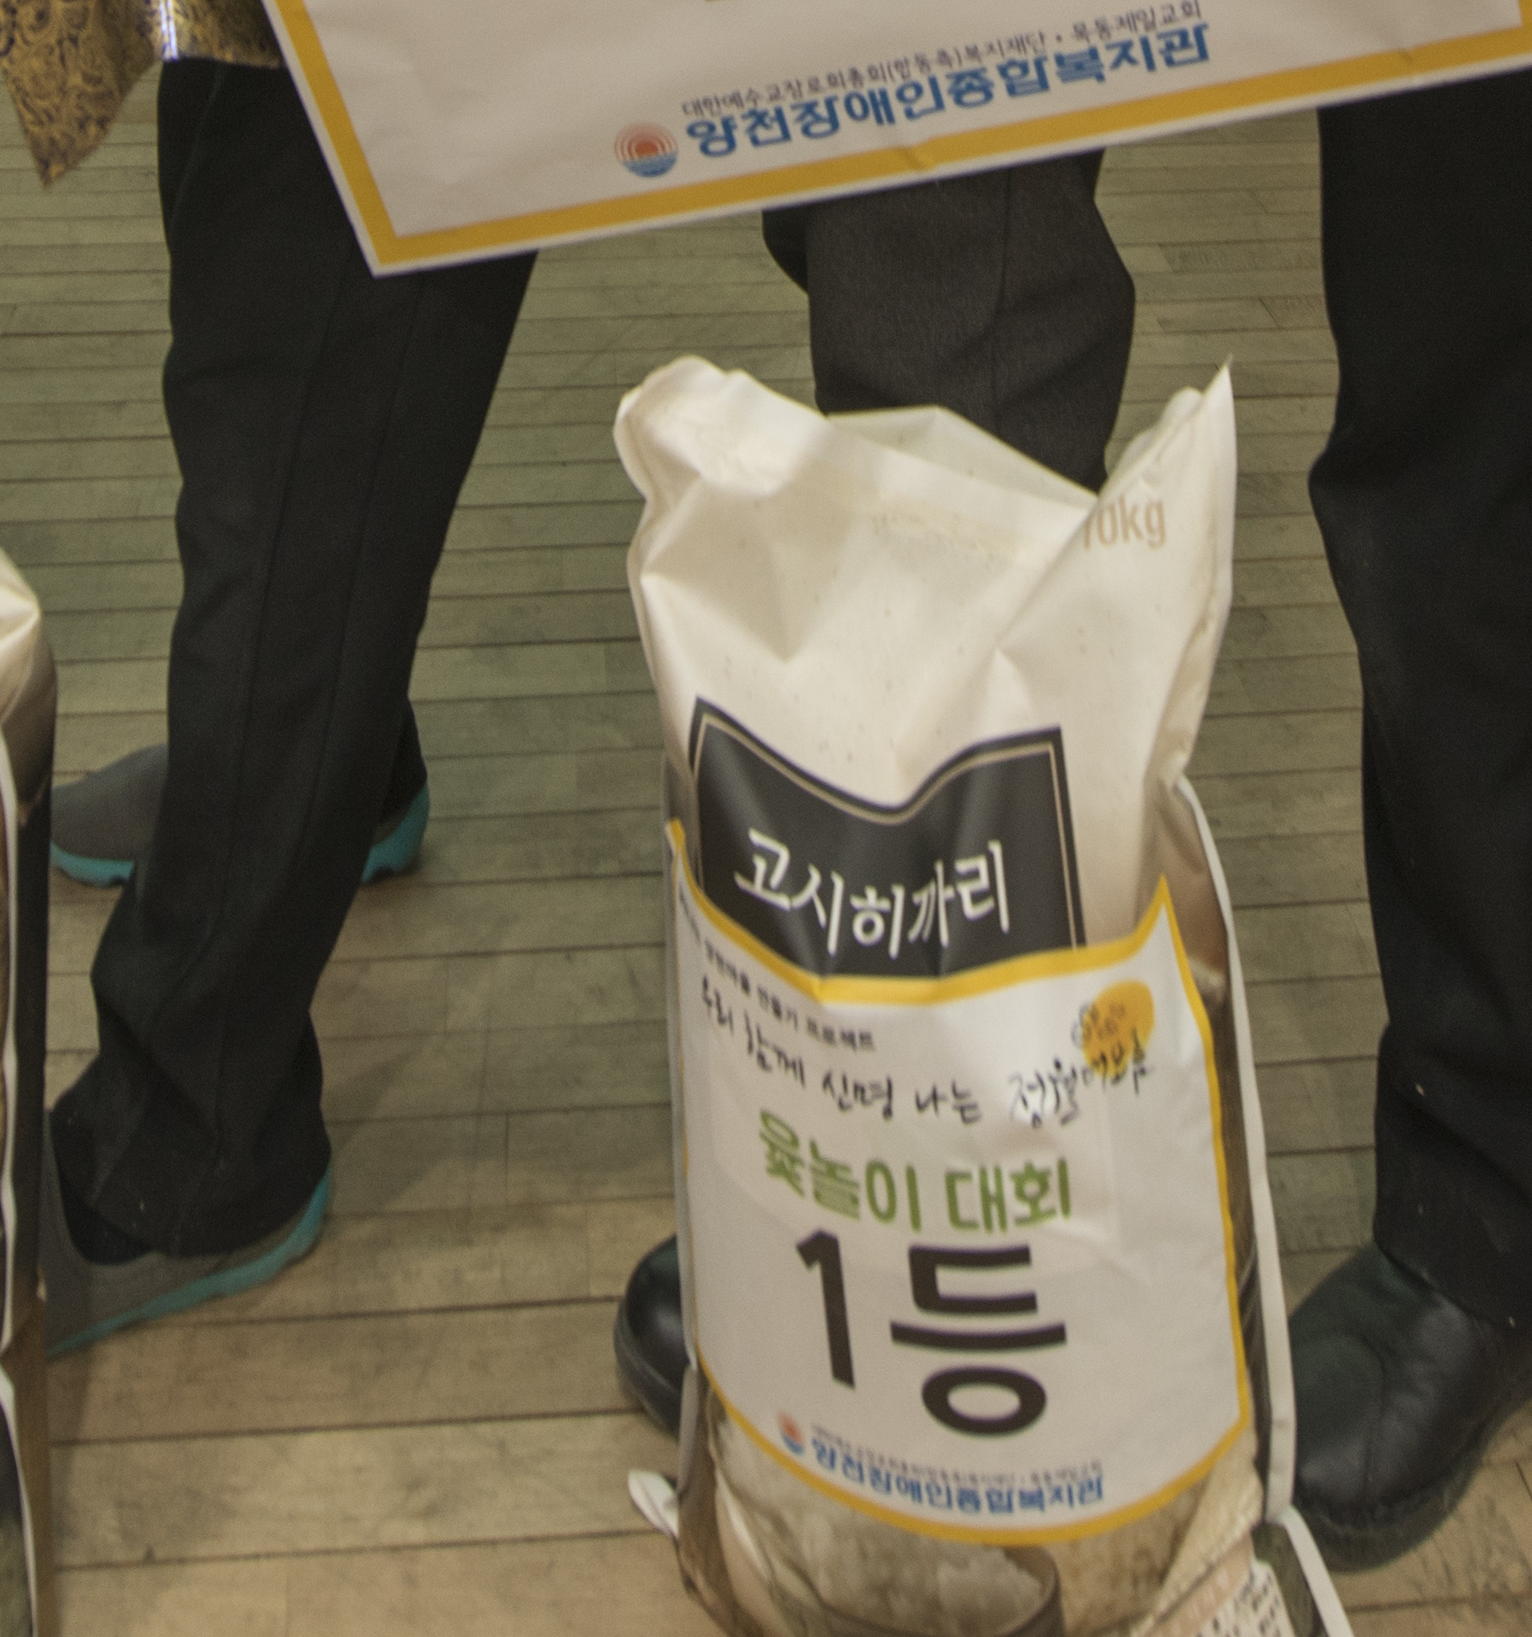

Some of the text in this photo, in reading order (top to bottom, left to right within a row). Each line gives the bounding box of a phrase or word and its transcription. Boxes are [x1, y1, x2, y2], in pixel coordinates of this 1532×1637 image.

[686, 22, 1210, 160] 양천장애인종합복지관
[734, 828, 1010, 959] 고시히까리
[759, 1106, 1071, 1234] 윷놀이 대회
[795, 1227, 1068, 1439] 1등
